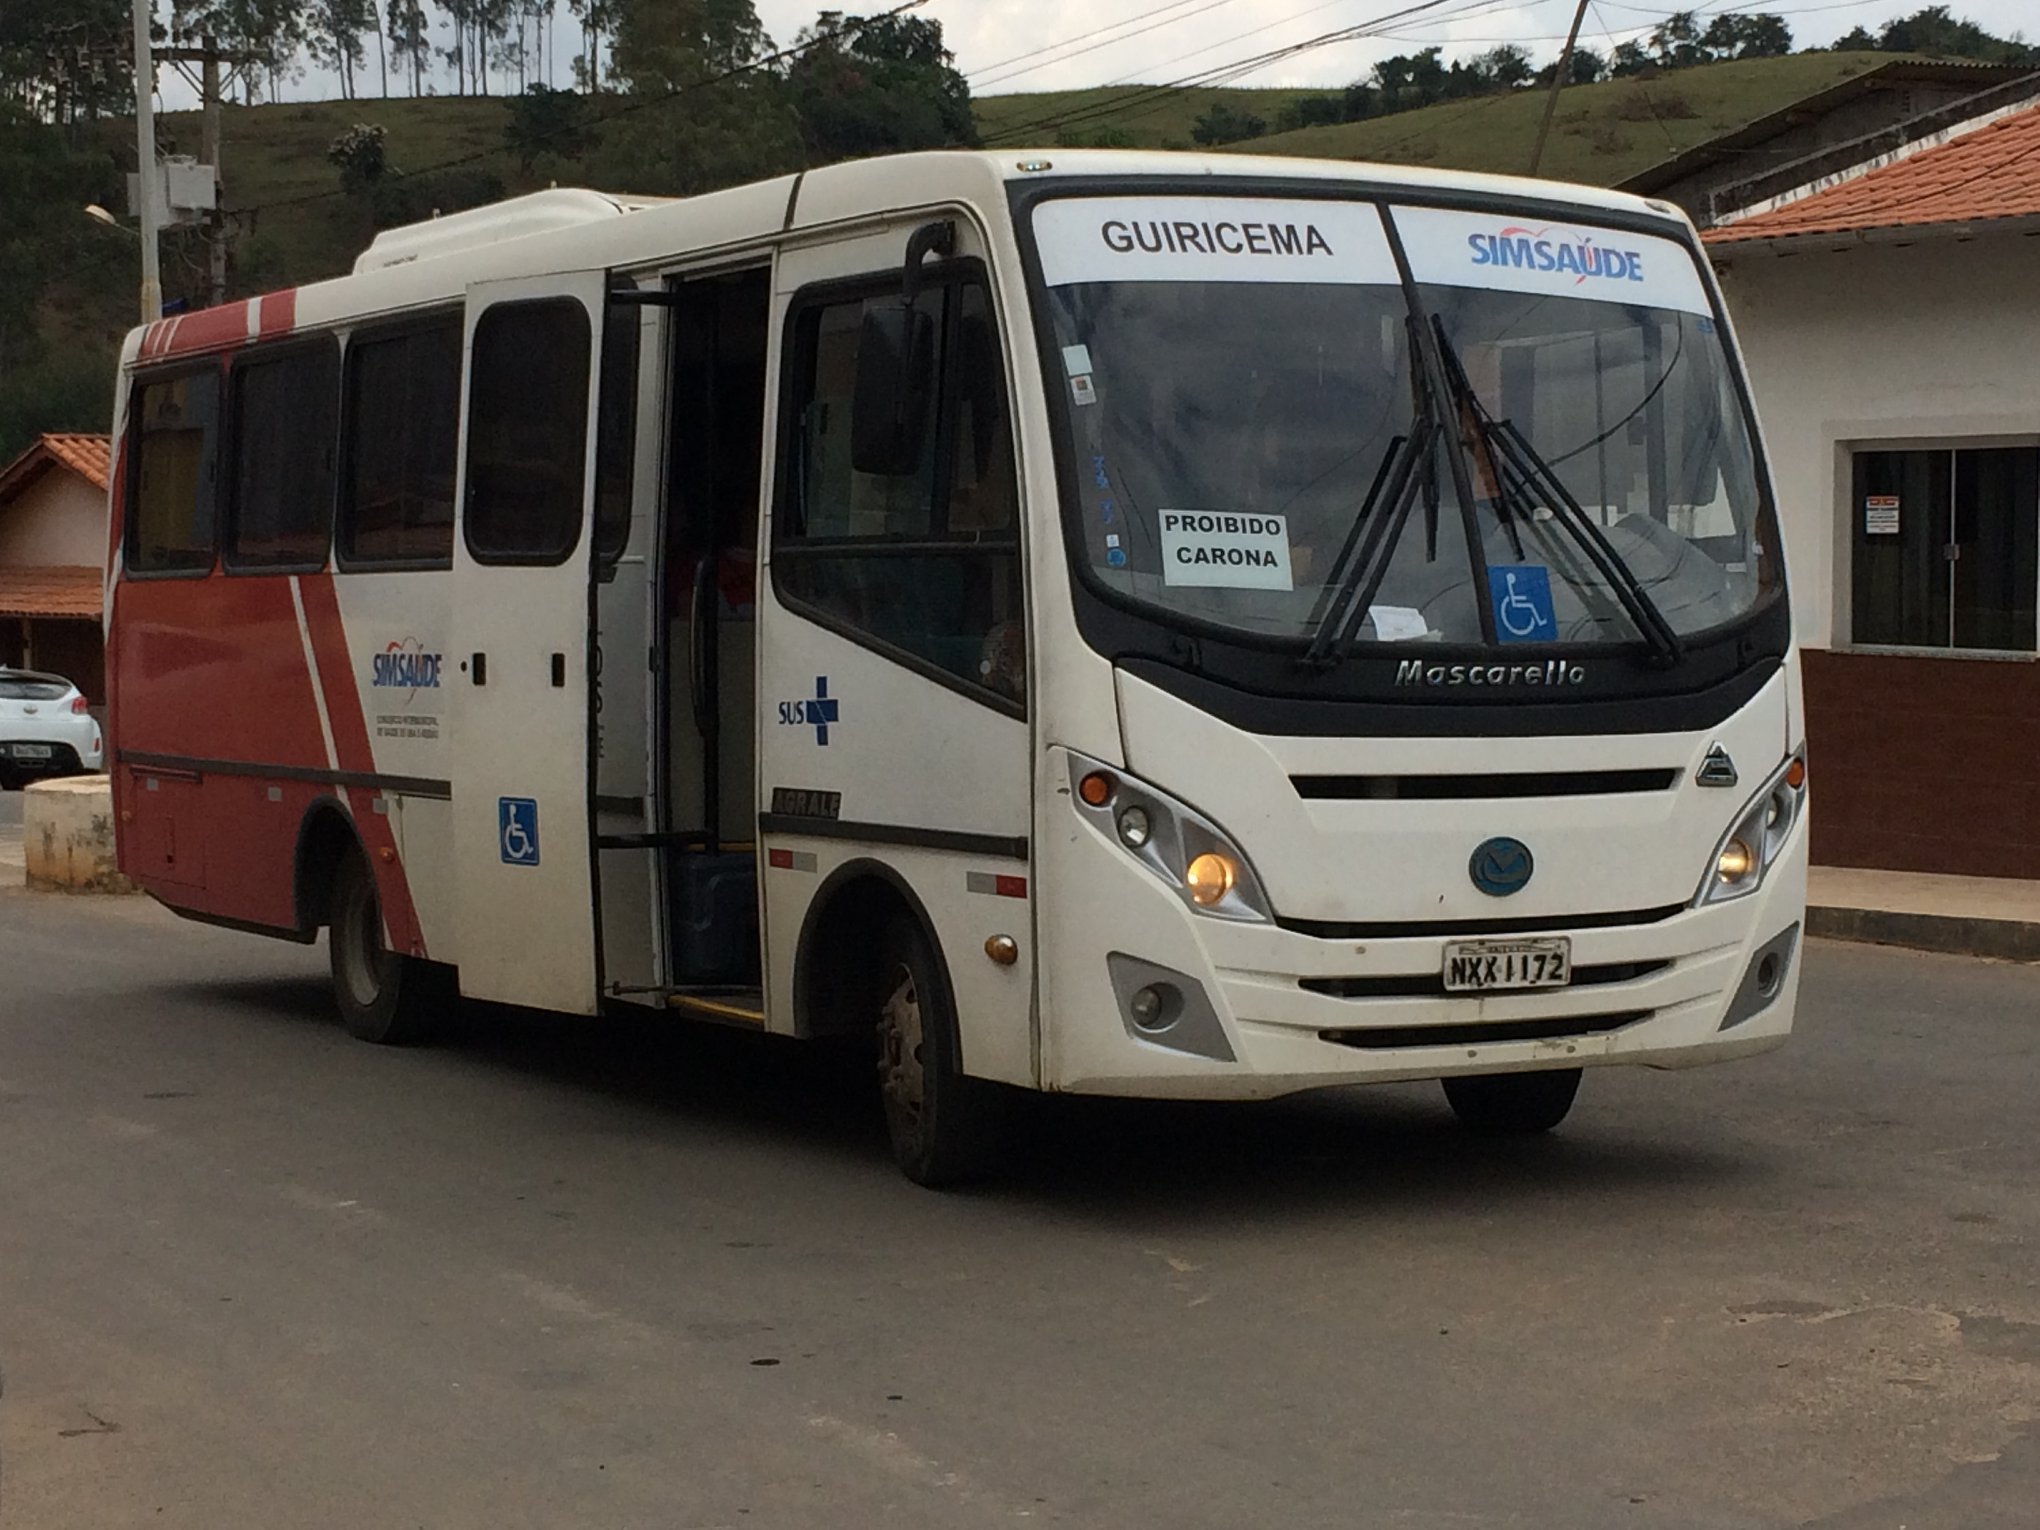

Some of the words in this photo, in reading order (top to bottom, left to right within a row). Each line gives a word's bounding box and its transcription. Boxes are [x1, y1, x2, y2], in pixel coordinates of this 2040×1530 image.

[1101, 220, 1334, 256] GUIRICEMA
[1467, 233, 1644, 282] SIMSAÚDE
[1165, 515, 1281, 536] PROIBIDO
[1176, 546, 1279, 568] CARONA
[1394, 659, 1586, 686] Mascarello
[778, 701, 804, 726] SUS
